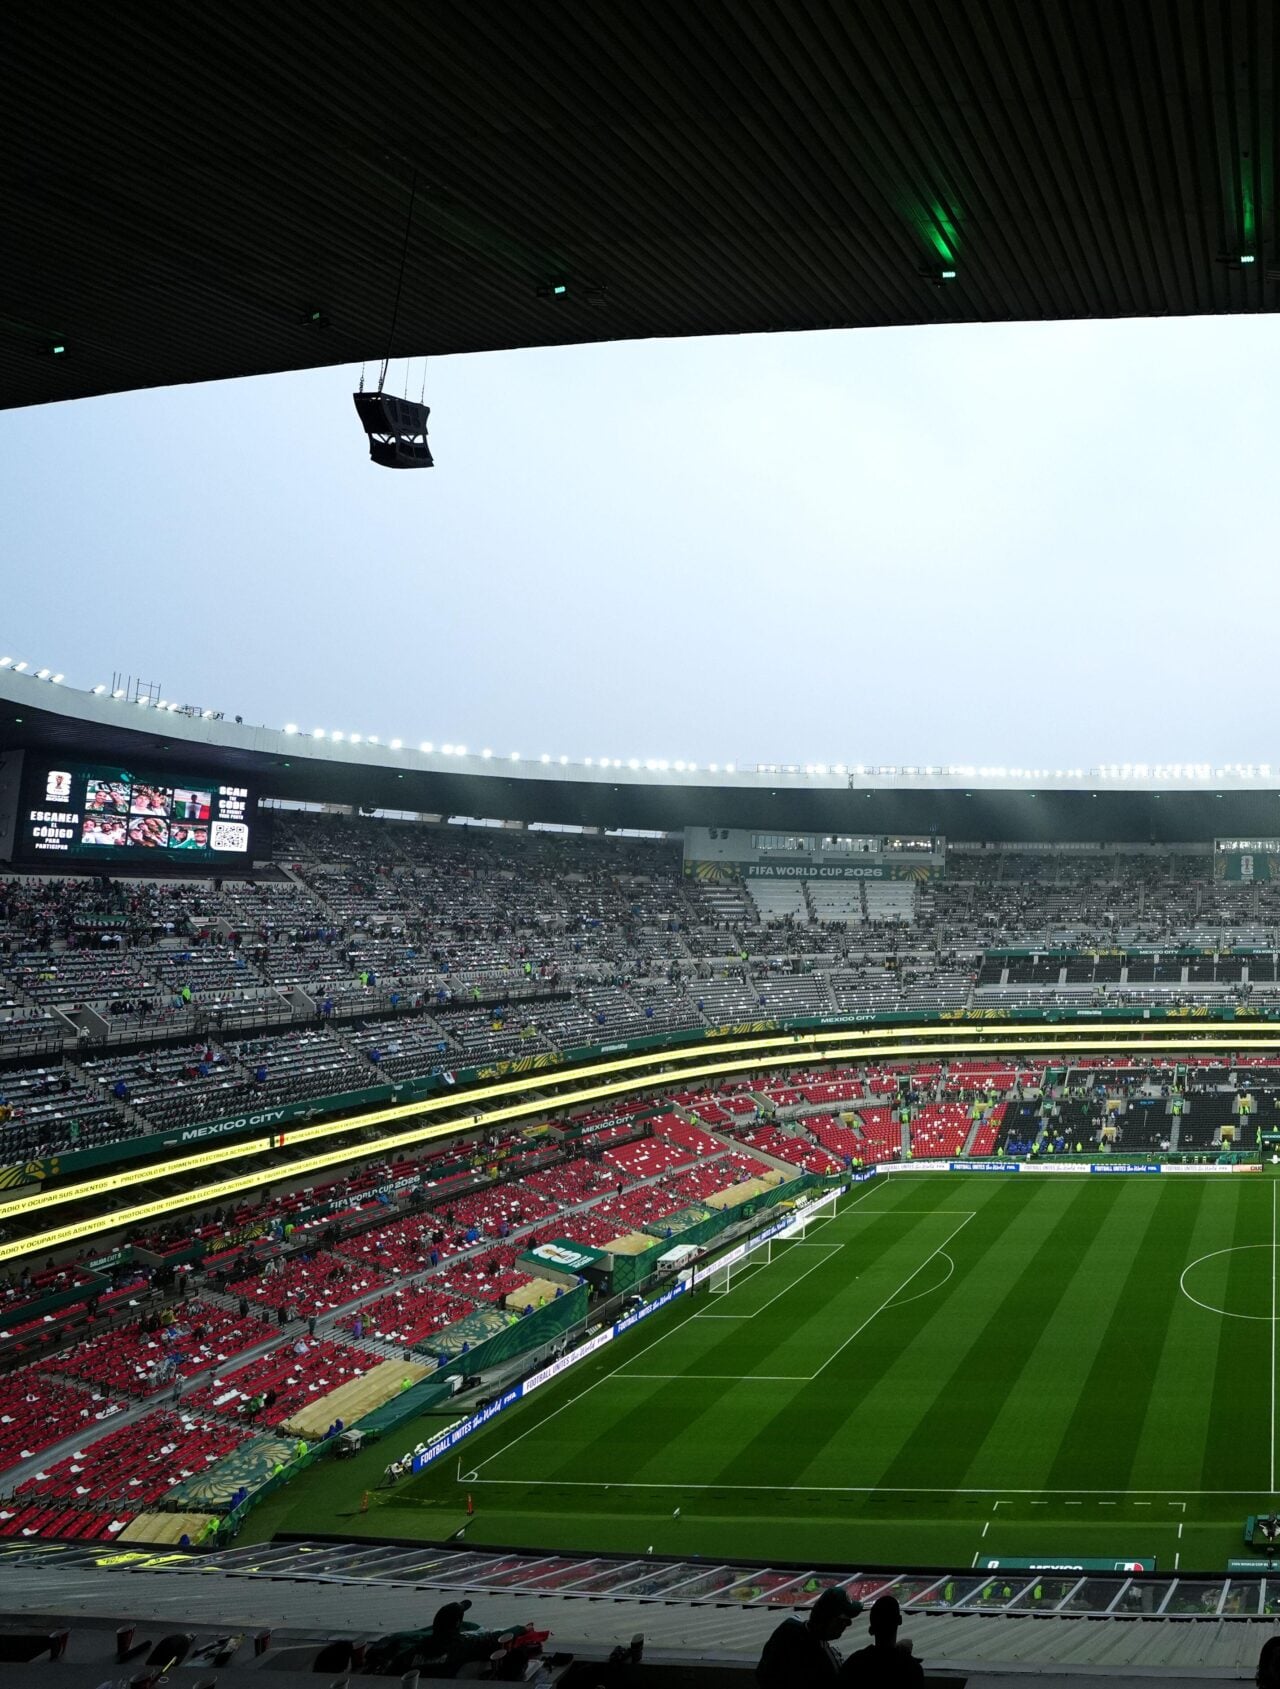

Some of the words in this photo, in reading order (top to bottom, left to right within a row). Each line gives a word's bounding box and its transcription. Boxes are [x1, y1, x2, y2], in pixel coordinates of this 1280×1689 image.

[219, 786, 248, 798] SCAN
[219, 800, 246, 810] CODE
[30, 811, 79, 824] ESCANEA
[33, 826, 73, 838] CÓDIGO
[749, 866, 774, 876] FIFA
[776, 866, 818, 876] WORLD
[820, 867, 842, 876] CUP
[844, 868, 883, 877] 2026
[182, 1118, 246, 1141] MEXICO
[250, 1111, 284, 1125] CITY
[581, 1121, 614, 1134] MEXICO
[616, 1114, 635, 1125] CITY
[121, 1168, 158, 1182] PROTOCOLO
[27, 1195, 58, 1206] OCUPAR
[59, 1191, 73, 1199] SUS
[75, 1182, 108, 1195] ASIENTOS
[330, 1199, 348, 1208] FIFA
[349, 1190, 378, 1203] WORLD
[379, 1184, 394, 1194] CUP
[394, 1175, 420, 1189] 2026
[118, 1206, 156, 1221] PROTOCOLO
[27, 1235, 56, 1248] OCUPAR
[57, 1230, 72, 1239] SUS
[73, 1220, 106, 1234] ASIENTOS
[618, 1313, 638, 1332] FOOTBALL
[638, 1304, 652, 1319] UNITES
[526, 1368, 551, 1390] FOOTBALL
[553, 1356, 570, 1373] UNITES
[598, 1334, 608, 1343] FIFA
[420, 1438, 451, 1466] FOOTBALL
[452, 1421, 472, 1443] UNITES
[473, 1415, 483, 1429] the
[483, 1399, 502, 1421] World
[504, 1392, 516, 1404] FIFA
